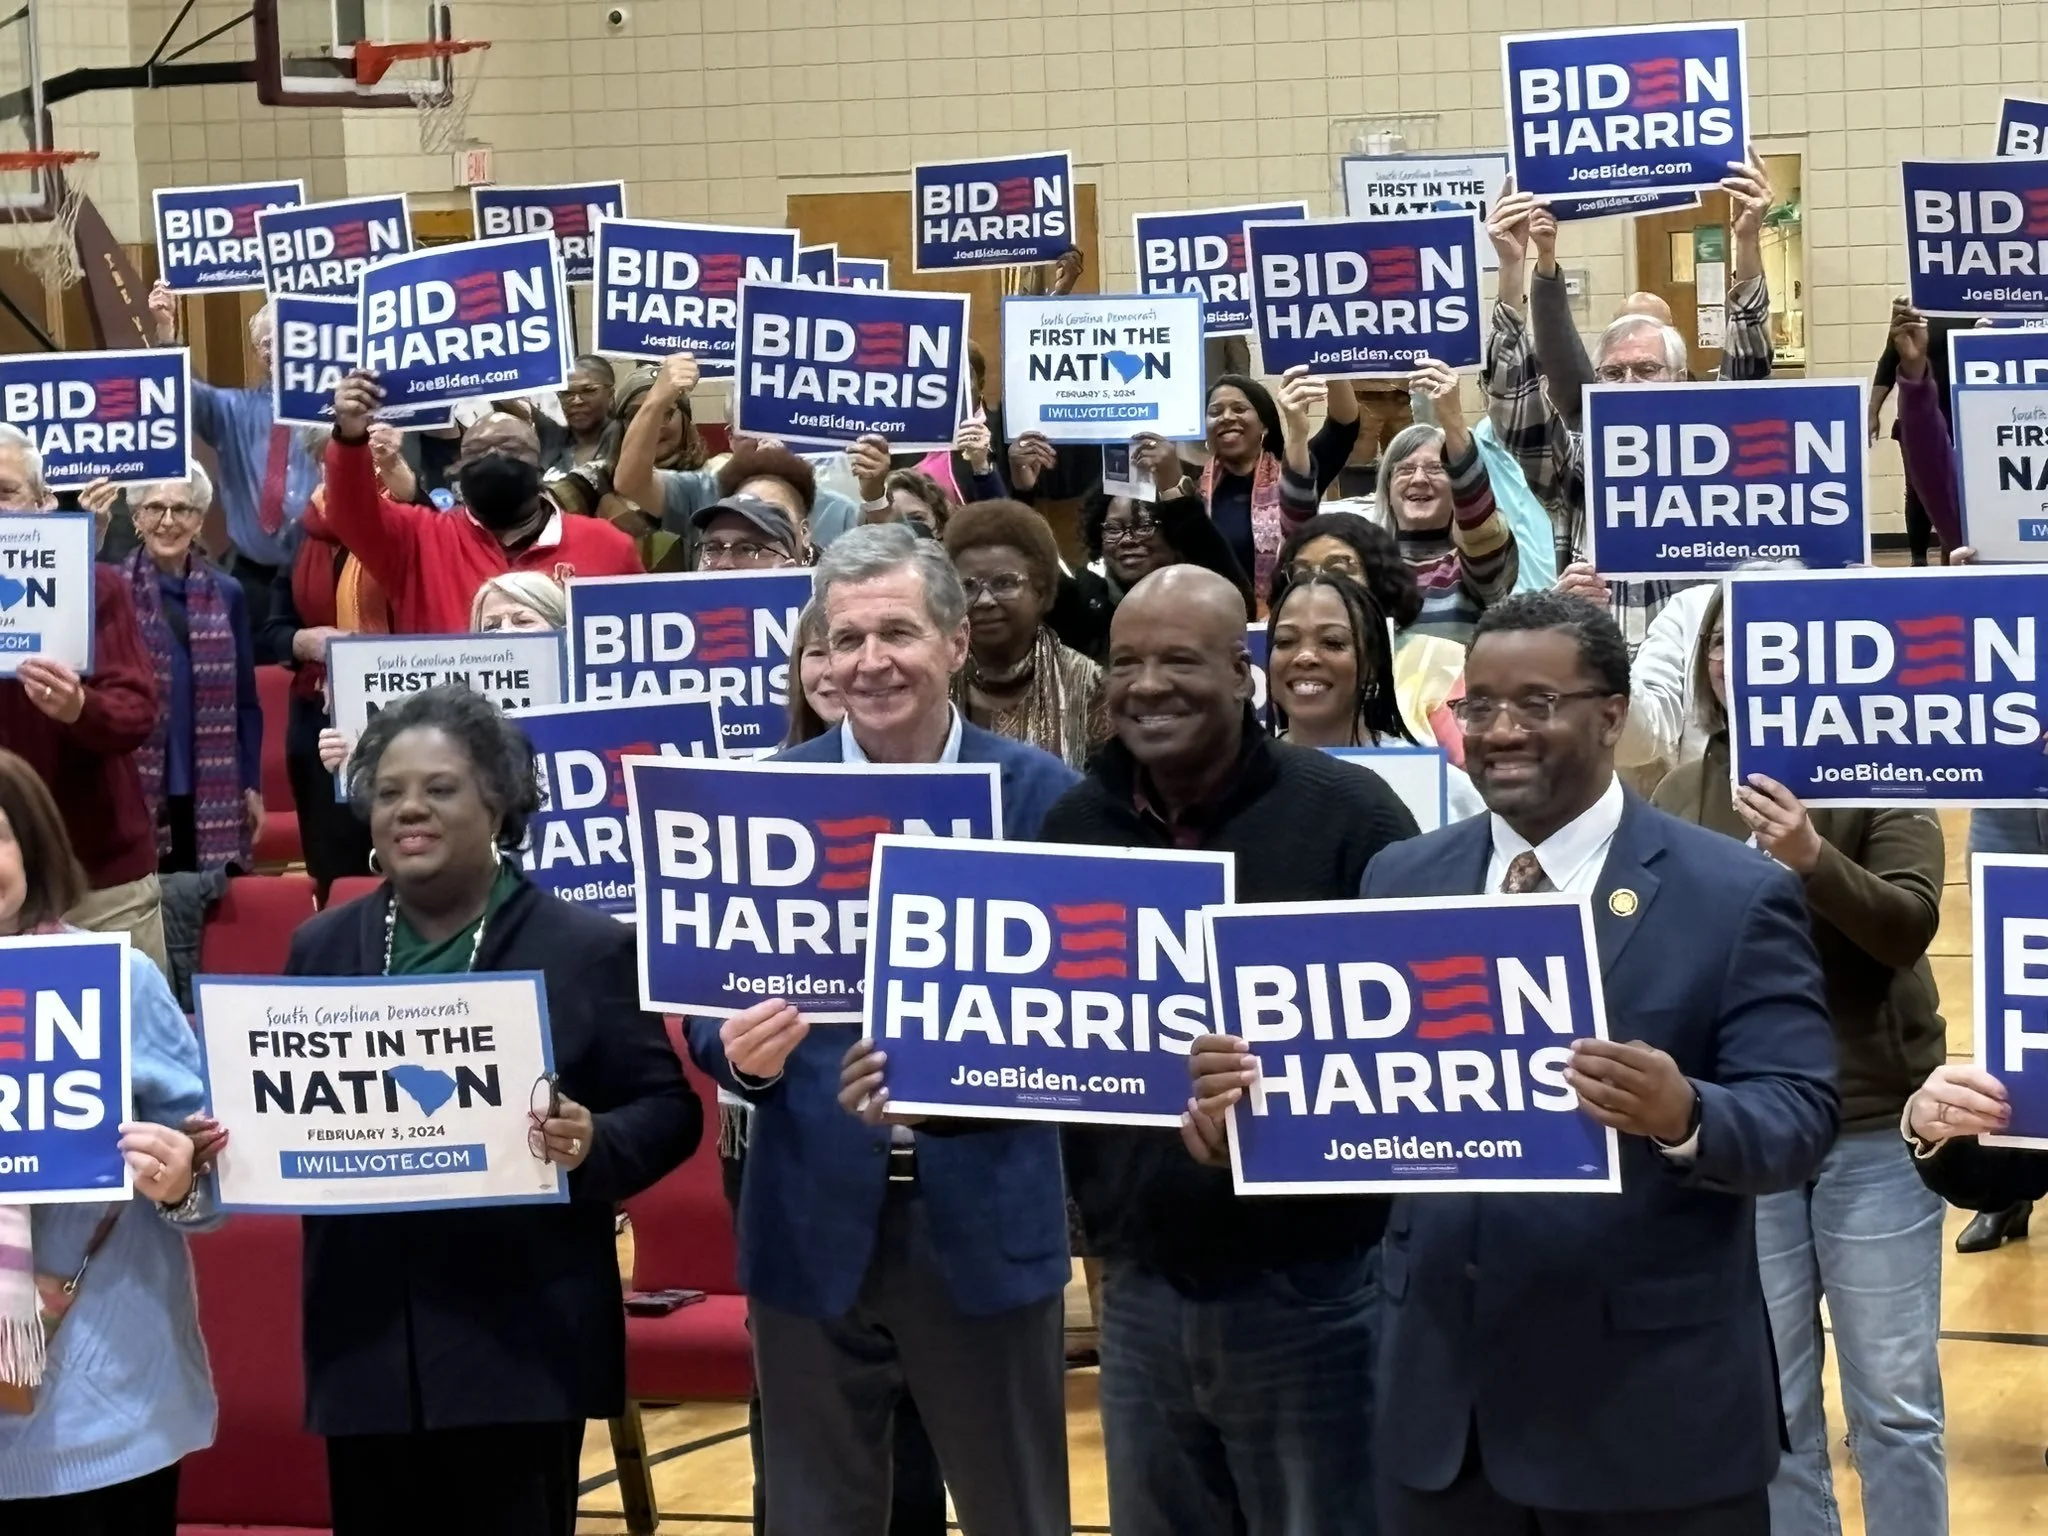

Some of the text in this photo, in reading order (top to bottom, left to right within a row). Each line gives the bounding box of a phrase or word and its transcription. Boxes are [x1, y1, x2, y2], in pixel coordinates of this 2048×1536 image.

[1519, 57, 1730, 115] BIDEN
[1522, 107, 1734, 158] HARRIS
[1367, 180, 1486, 198] FIRST IN THE
[1568, 161, 1692, 182] JoeBiden.com
[923, 175, 1063, 216] BIDEN
[1914, 189, 2048, 236] BID
[266, 217, 401, 266] BIDEN
[923, 211, 1066, 244] HARRIS
[167, 238, 264, 268] HARR
[608, 246, 783, 292] BIDEN
[1917, 240, 2048, 276] HAR
[1261, 245, 1465, 299] BIDEN
[367, 266, 546, 336] BIDEN
[607, 290, 738, 329] HARR
[1962, 288, 2048, 302] JoeBiden.
[1029, 326, 1171, 347] FIRST IN THE
[1266, 296, 1470, 340] HARRIS
[366, 315, 551, 371] HARRIS
[641, 333, 737, 351] JoeBiden.co
[752, 312, 950, 369] BIDEN
[1309, 347, 1429, 365] JoeBiden.com
[4, 376, 176, 422] BIDEN
[407, 367, 518, 394] JoeBiden.com
[750, 361, 948, 410] HARRIS
[788, 411, 906, 433] JoeBiden.com
[1048, 406, 1150, 419] IWILLVOTE.COM
[1602, 420, 1847, 478] BIDEN
[44, 461, 145, 478] JoeBiden.com
[1605, 481, 1850, 528] HARRIS
[3, 549, 56, 569] THE
[1656, 541, 1801, 559] JoeBiden.com
[584, 606, 799, 666] BIDEN
[1746, 615, 2036, 686] BIDEN
[377, 648, 515, 671] South Carolina Democrats
[364, 671, 437, 693] FIRST
[478, 669, 530, 691] THE
[585, 664, 791, 707] HARRIS
[1747, 692, 2041, 747] HARRIS
[1809, 762, 1984, 784] JoeBiden.com
[654, 809, 971, 889] BIDE
[889, 893, 1207, 984] BIDEN
[721, 972, 866, 996] JoeBiden.
[1234, 955, 1574, 1043] BIDEN
[266, 998, 471, 1027] South Carolina Democrats
[885, 979, 1211, 1057] HARRIS
[248, 1025, 497, 1058] FIRST IN THE
[950, 1065, 1146, 1095] JoeBiden.com
[1248, 1046, 1580, 1117] HARRIS
[307, 1127, 386, 1142] FEBRUARY
[407, 1124, 447, 1140] 2024
[1323, 1135, 1522, 1162] JoeBiden.com
[296, 1150, 471, 1174] IWILLVOTE.COM
